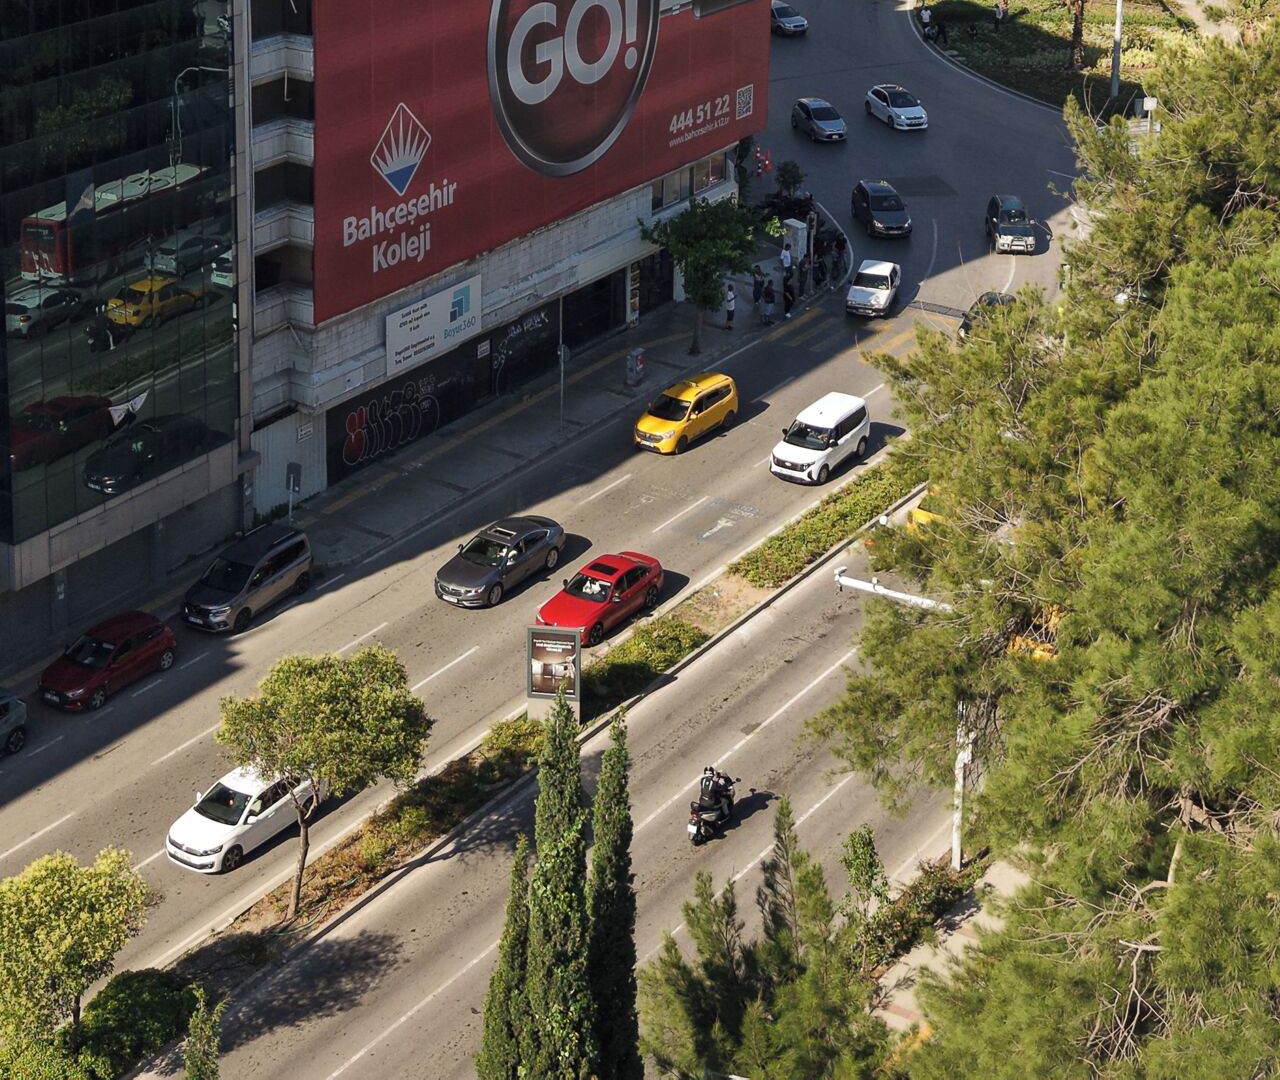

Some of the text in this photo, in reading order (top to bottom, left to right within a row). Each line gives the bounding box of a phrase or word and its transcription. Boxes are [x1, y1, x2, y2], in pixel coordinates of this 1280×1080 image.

[669, 94, 730, 134] 444 51 22
[342, 178, 457, 248] Bahçeşehir
[372, 230, 431, 274] Koleji
